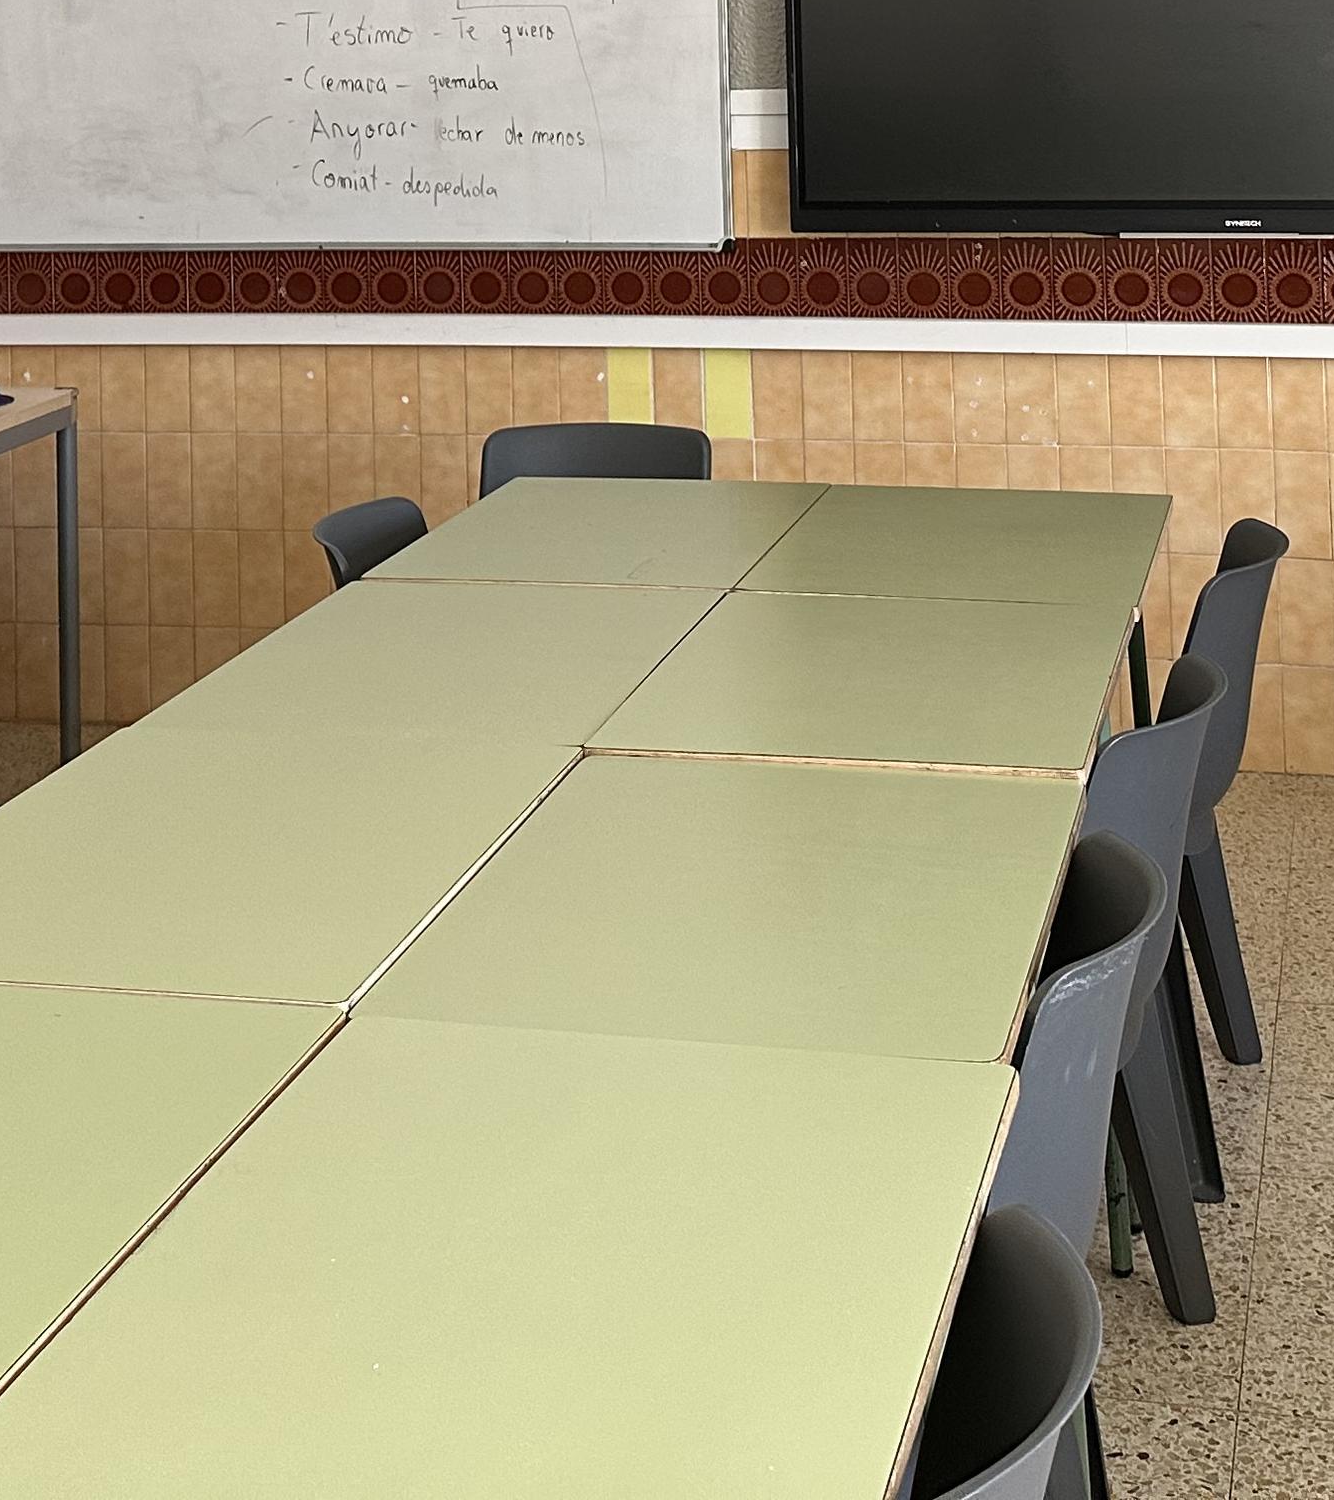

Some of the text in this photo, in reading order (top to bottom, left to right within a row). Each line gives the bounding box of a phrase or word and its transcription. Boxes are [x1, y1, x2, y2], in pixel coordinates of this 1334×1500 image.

[451, 16, 478, 41] Te
[501, 24, 555, 56] quiero
[504, 118, 524, 147] de
[531, 128, 586, 148] menos
